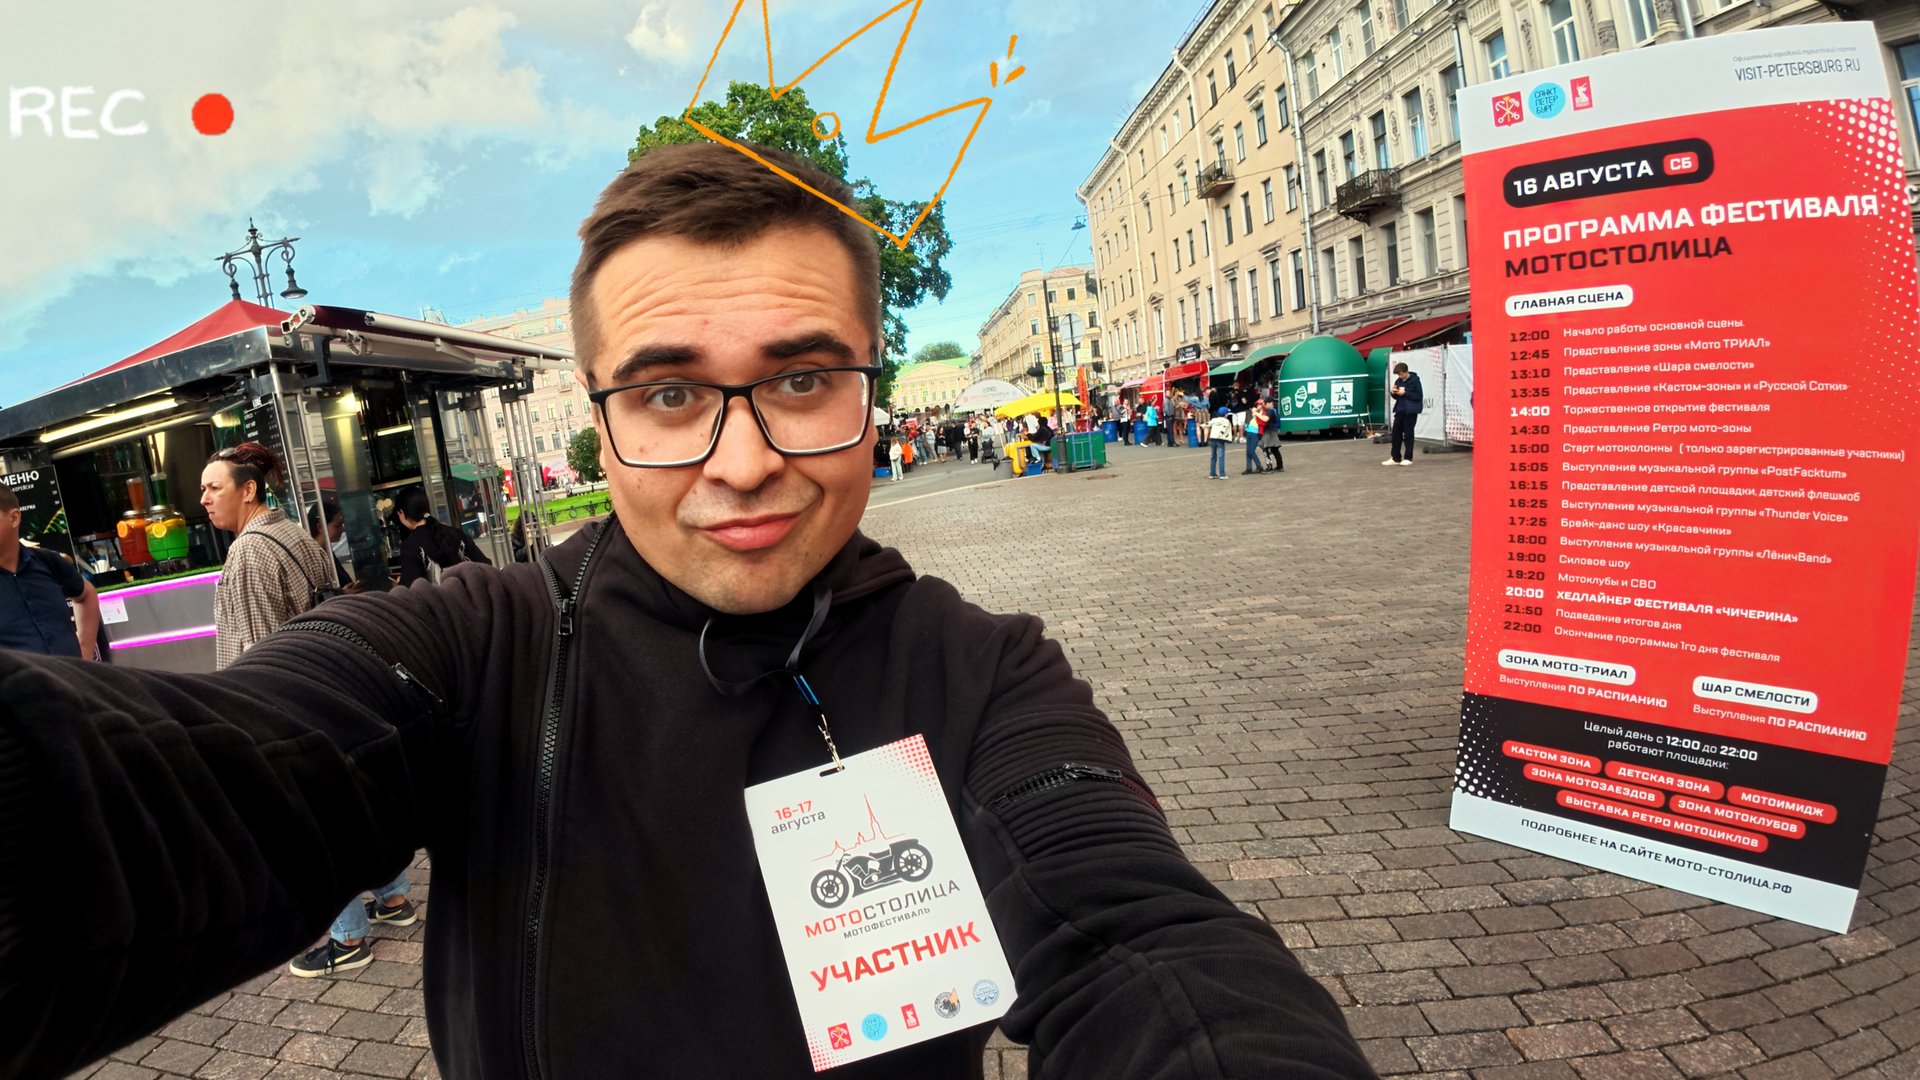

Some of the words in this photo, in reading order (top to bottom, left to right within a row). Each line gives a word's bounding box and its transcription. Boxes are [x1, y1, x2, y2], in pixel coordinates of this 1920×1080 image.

[1735, 58, 1860, 81] VISIT-PETERSBURG.RU
[1534, 88, 1557, 98] САНКТ
[1536, 96, 1558, 106] ПЕТЕР
[1536, 105, 1553, 114] БУРГ
[1670, 157, 1693, 171] СБ
[1513, 178, 1538, 197] 16
[1543, 160, 1654, 193] АВГУСТА
[1504, 207, 1694, 250] ПРОГРАММА
[1701, 194, 1879, 226] ФЕСТИВАЛЯ
[1505, 236, 1733, 278] МОТОСТОЛИЦА
[1514, 296, 1574, 310] ГЛАВНАЯ
[1578, 291, 1624, 304] СЦЕНА
[1510, 330, 1550, 342] 12:00
[1564, 326, 1605, 337] Начало
[1607, 324, 1647, 336] работы
[1650, 319, 1705, 331] основной
[1707, 319, 1745, 328] сцены.
[1511, 350, 1550, 361] 12:45
[1564, 343, 1650, 357] Представление
[1653, 343, 1681, 351] зоны
[1684, 340, 1720, 350] «Мото
[1723, 338, 1771, 349] ТРИАЛ»
[1511, 369, 1550, 379] 13:10
[1564, 363, 1650, 376] Представление
[1653, 362, 1690, 372] «Шара
[1693, 361, 1755, 371] смелости»
[1511, 388, 1550, 398] 13:35
[1564, 384, 1650, 395] Представление
[1653, 382, 1741, 392] «Кастом-зоны»
[1744, 383, 1750, 391] и
[1753, 380, 1806, 392] «Русской
[1809, 380, 1848, 391] Сотки»
[1510, 406, 1550, 417] 14:00
[1564, 405, 1650, 415] Торжественное
[1653, 404, 1706, 414] открытие
[1708, 403, 1770, 414] фестиваля
[1510, 425, 1550, 435] 14:30
[1564, 424, 1650, 434] Представление
[1653, 423, 1686, 434] Ретро
[1689, 424, 1752, 433] мото-зоны
[1510, 444, 1549, 453] 15:00
[1563, 444, 1594, 453] Старт
[1597, 445, 1672, 453] мотоколонны
[1726, 445, 1845, 457] зарегистрированные
[1847, 449, 1905, 462] участники)
[0, 470, 39, 486] МЕНЮ
[1509, 463, 1548, 472] 15:05
[1562, 462, 1637, 472] Выступление
[1639, 462, 1716, 474] музыкальной
[1718, 466, 1758, 475] группы
[1761, 466, 1847, 478] «PostFacktum»
[1509, 481, 1548, 490] 16:15
[1562, 481, 1647, 492] Представление
[1650, 483, 1696, 493] детской
[1759, 488, 1805, 498] детский
[1808, 490, 1860, 501] флешмоб
[1509, 499, 1547, 508] 16:25
[1562, 500, 1634, 511] Выступление
[1638, 502, 1713, 514] музыкальной
[1716, 506, 1756, 516] группы
[1759, 508, 1810, 519] «Thunder
[1813, 511, 1848, 522] Voice»
[1509, 517, 1547, 526] 17:25
[1561, 518, 1625, 530] Брейк-данс
[1628, 523, 1649, 532] шоу
[1652, 523, 1731, 535] «Красавчики»
[1508, 535, 1546, 545] 18:00
[1560, 536, 1633, 549] Выступление
[1635, 541, 1711, 555] музыкальной
[1714, 547, 1753, 558] группы
[1756, 549, 1831, 564] «ЛёничBand»
[1508, 552, 1546, 563] 19:00
[1559, 555, 1606, 566] Силовое
[1608, 560, 1630, 569] шоу
[1507, 570, 1545, 581] 19:20
[1558, 573, 1619, 586] Мотоклубы
[1630, 579, 1656, 589] СВО
[1505, 604, 1542, 616] 21:50
[1556, 609, 1621, 624] Подведение
[1624, 618, 1660, 628] итогов
[1662, 622, 1681, 630] дня
[1506, 587, 1544, 598] 20:00
[1557, 590, 1631, 605] ХЕДЛАЙНЕР
[1634, 598, 1713, 614] ФЕСТИВАЛЯ
[1716, 606, 1798, 623] «ЧИЧЕРИНА»
[1504, 621, 1541, 633] 22:00
[1554, 627, 1613, 641] Окончание
[1616, 635, 1678, 649] программы
[1681, 641, 1696, 651] 1го
[1698, 645, 1718, 654] дня
[1721, 646, 1780, 662] фестиваля
[1505, 655, 1539, 667] ЗОНА
[1542, 660, 1627, 679] МОТО-ТРИАЛ
[1499, 674, 1566, 691] Выступления
[1569, 685, 1585, 695] ПО
[1588, 688, 1667, 707] РАСПИАНИЮ
[1701, 682, 1732, 694] ШАР
[1735, 687, 1810, 706] СМЕЛОСТИ
[1693, 704, 1766, 723] Выступления
[1768, 716, 1785, 727] ПО
[1788, 719, 1866, 740] РАСПИАНИЮ
[1584, 721, 1623, 735] Целый
[1625, 730, 1653, 741] день
[1666, 735, 1700, 750] 12:00
[1702, 744, 1717, 754] до
[1720, 746, 1758, 761] 22:00
[1511, 745, 1557, 761] КАСТОМ
[1560, 757, 1591, 768] ЗОНА
[1608, 740, 1664, 757] работают
[1667, 751, 1729, 769] площадки:
[1532, 768, 1562, 781] ЗОНА
[1566, 774, 1655, 801] МОТОЗАЕЗДОВ
[1618, 767, 1674, 785] ДЕТСКАЯ
[1677, 779, 1710, 793] ЗОНА
[775, 800, 813, 821] 16-17
[1678, 800, 1711, 813] ЗОНА
[1714, 808, 1797, 833] МОТОКЛУБОВ
[1741, 792, 1824, 817] МОТОИМИДЖ
[771, 811, 826, 835] августа
[1566, 796, 1628, 817] ВЫСТАВКА
[1632, 812, 1671, 827] РЕТРО
[1674, 822, 1758, 847] МОТОЦИКЛОВ
[1521, 819, 1597, 845] ПОДРОБНЕЕ
[1600, 839, 1617, 850] НА
[1620, 844, 1662, 862] САЙТЕ
[1665, 856, 1792, 894] МОТО-СТОЛИЦА.РФ
[805, 880, 961, 938] МОТОСТОЛИЦА
[843, 907, 931, 939] МОТОФЕСТИВАЛЬ
[810, 921, 981, 991] УЧАСТНИК
